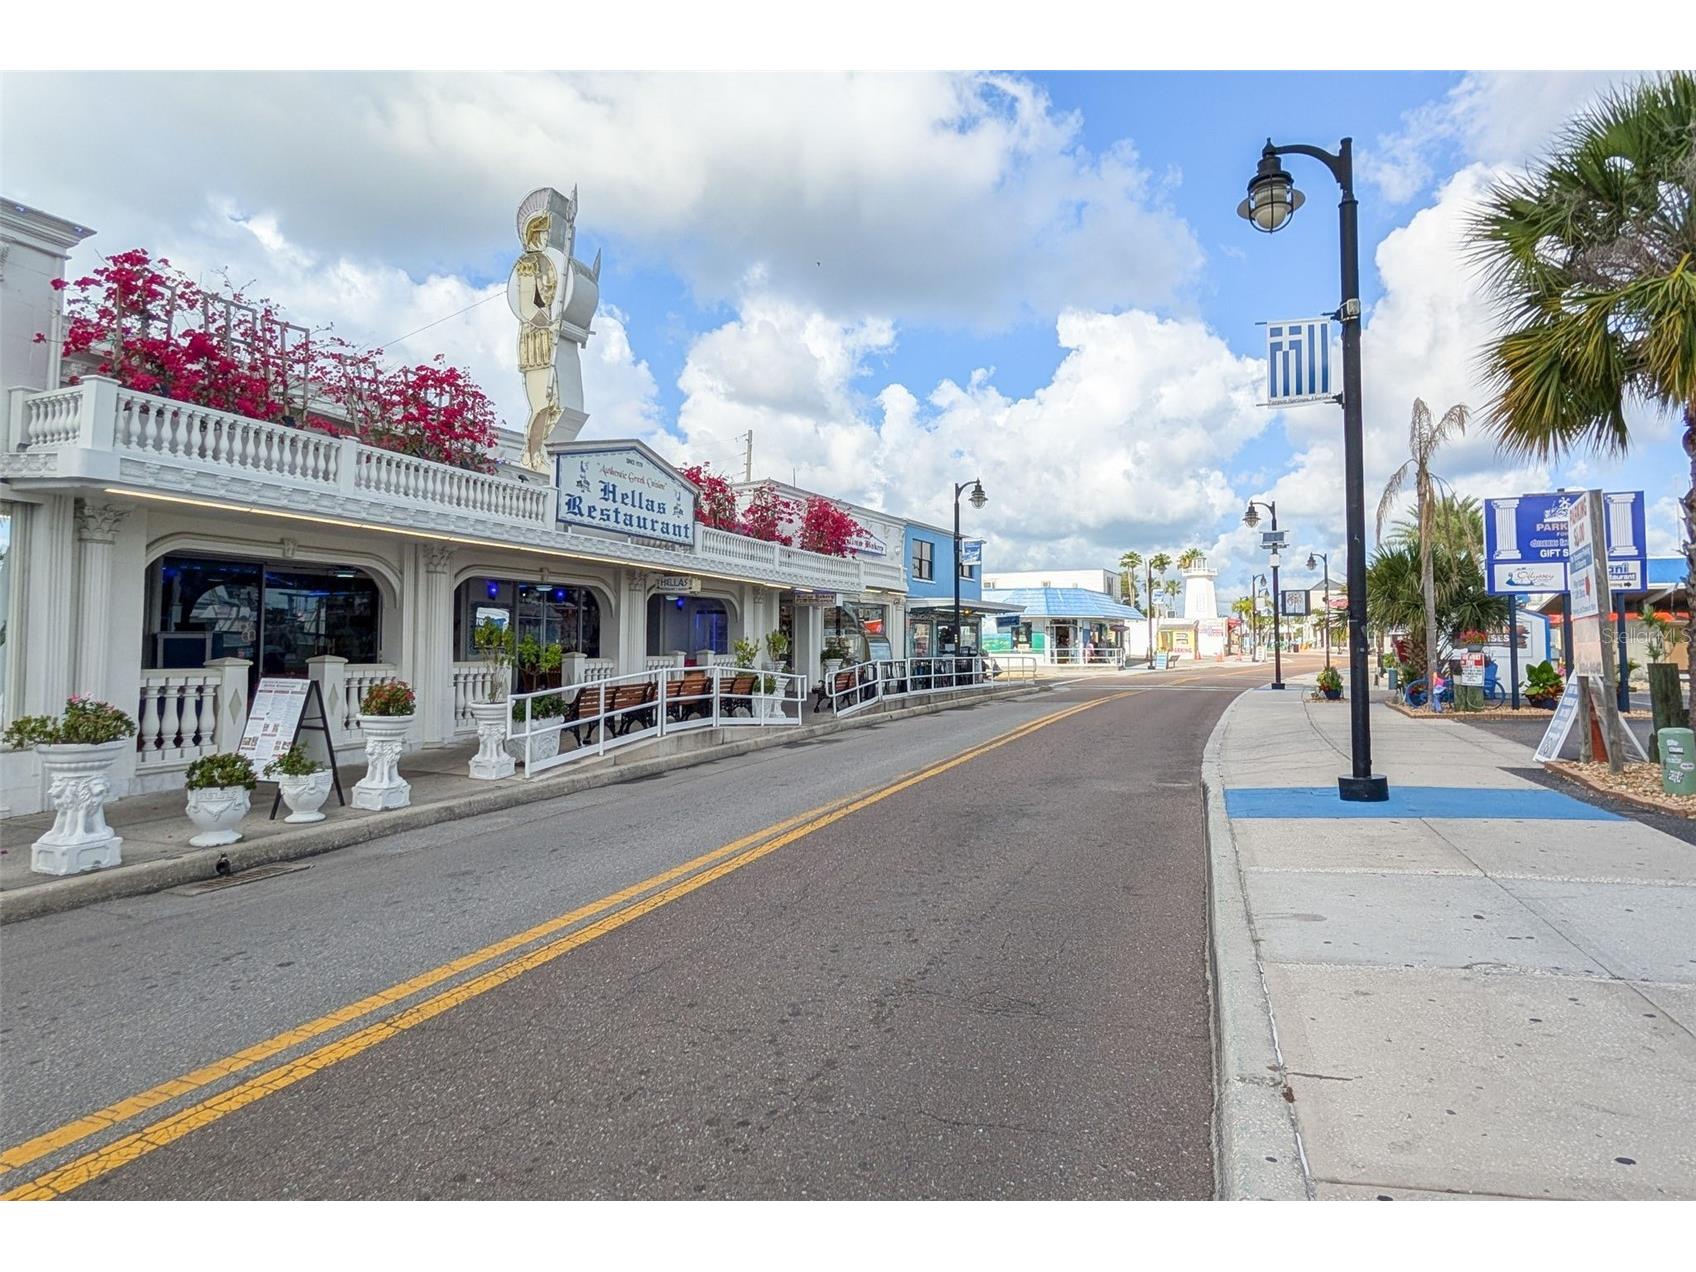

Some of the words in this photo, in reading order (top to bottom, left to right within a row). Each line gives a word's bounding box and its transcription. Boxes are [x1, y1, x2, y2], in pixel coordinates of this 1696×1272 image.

[598, 479, 667, 515] Hellas
[565, 493, 691, 539] Restaurant
[1536, 523, 1568, 532] PARK
[1540, 549, 1561, 558] GIFT
[1562, 548, 1569, 557] S
[660, 577, 688, 587] HELLAS
